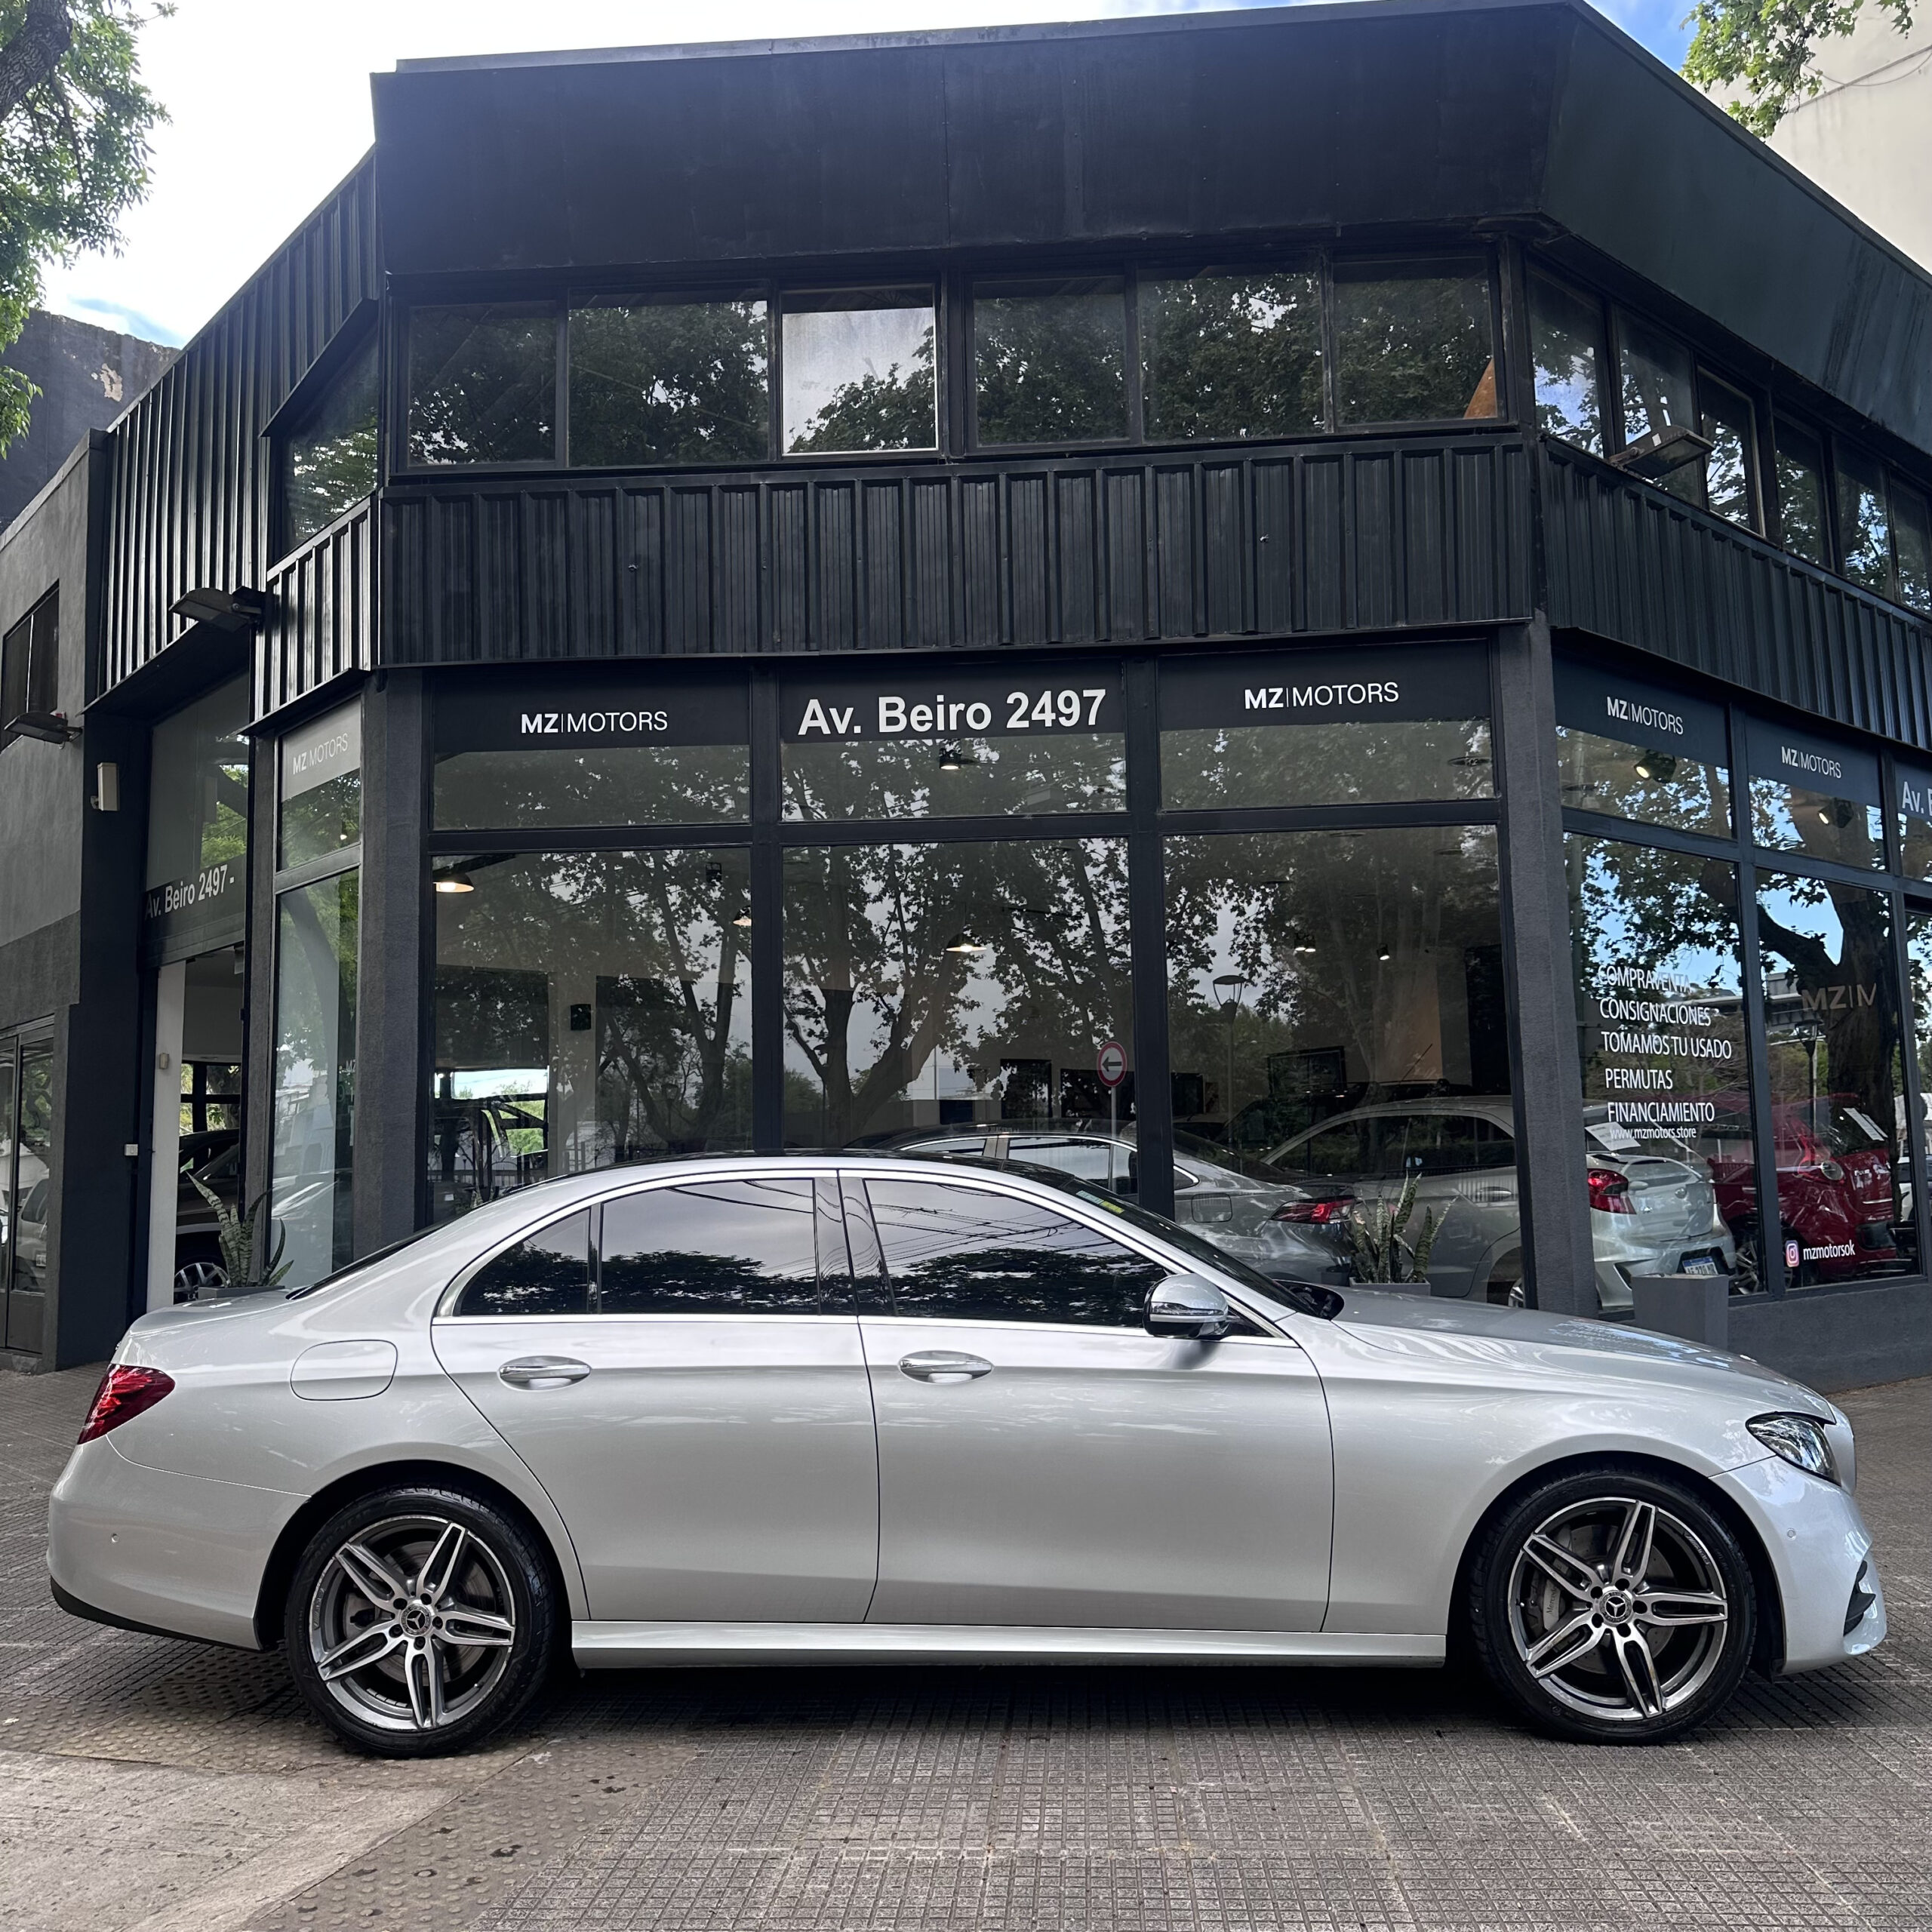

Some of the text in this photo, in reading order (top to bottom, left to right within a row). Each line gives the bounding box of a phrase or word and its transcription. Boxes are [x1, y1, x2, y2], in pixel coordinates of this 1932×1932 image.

[798, 689, 1106, 736] Av. Beiro 2497
[1902, 781, 1924, 814] Av.
[165, 880, 195, 913] Beiro
[198, 864, 227, 901] 2497
[1599, 998, 1712, 1027] CONSIGNACIONES
[1601, 1031, 1732, 1060] TOMAMOS TU USADO
[1604, 1068, 1673, 1090] PERMUTAS
[1607, 1102, 1715, 1122] FINANCIAMIENTO
[1803, 1238, 1856, 1260] mzmotorsok
